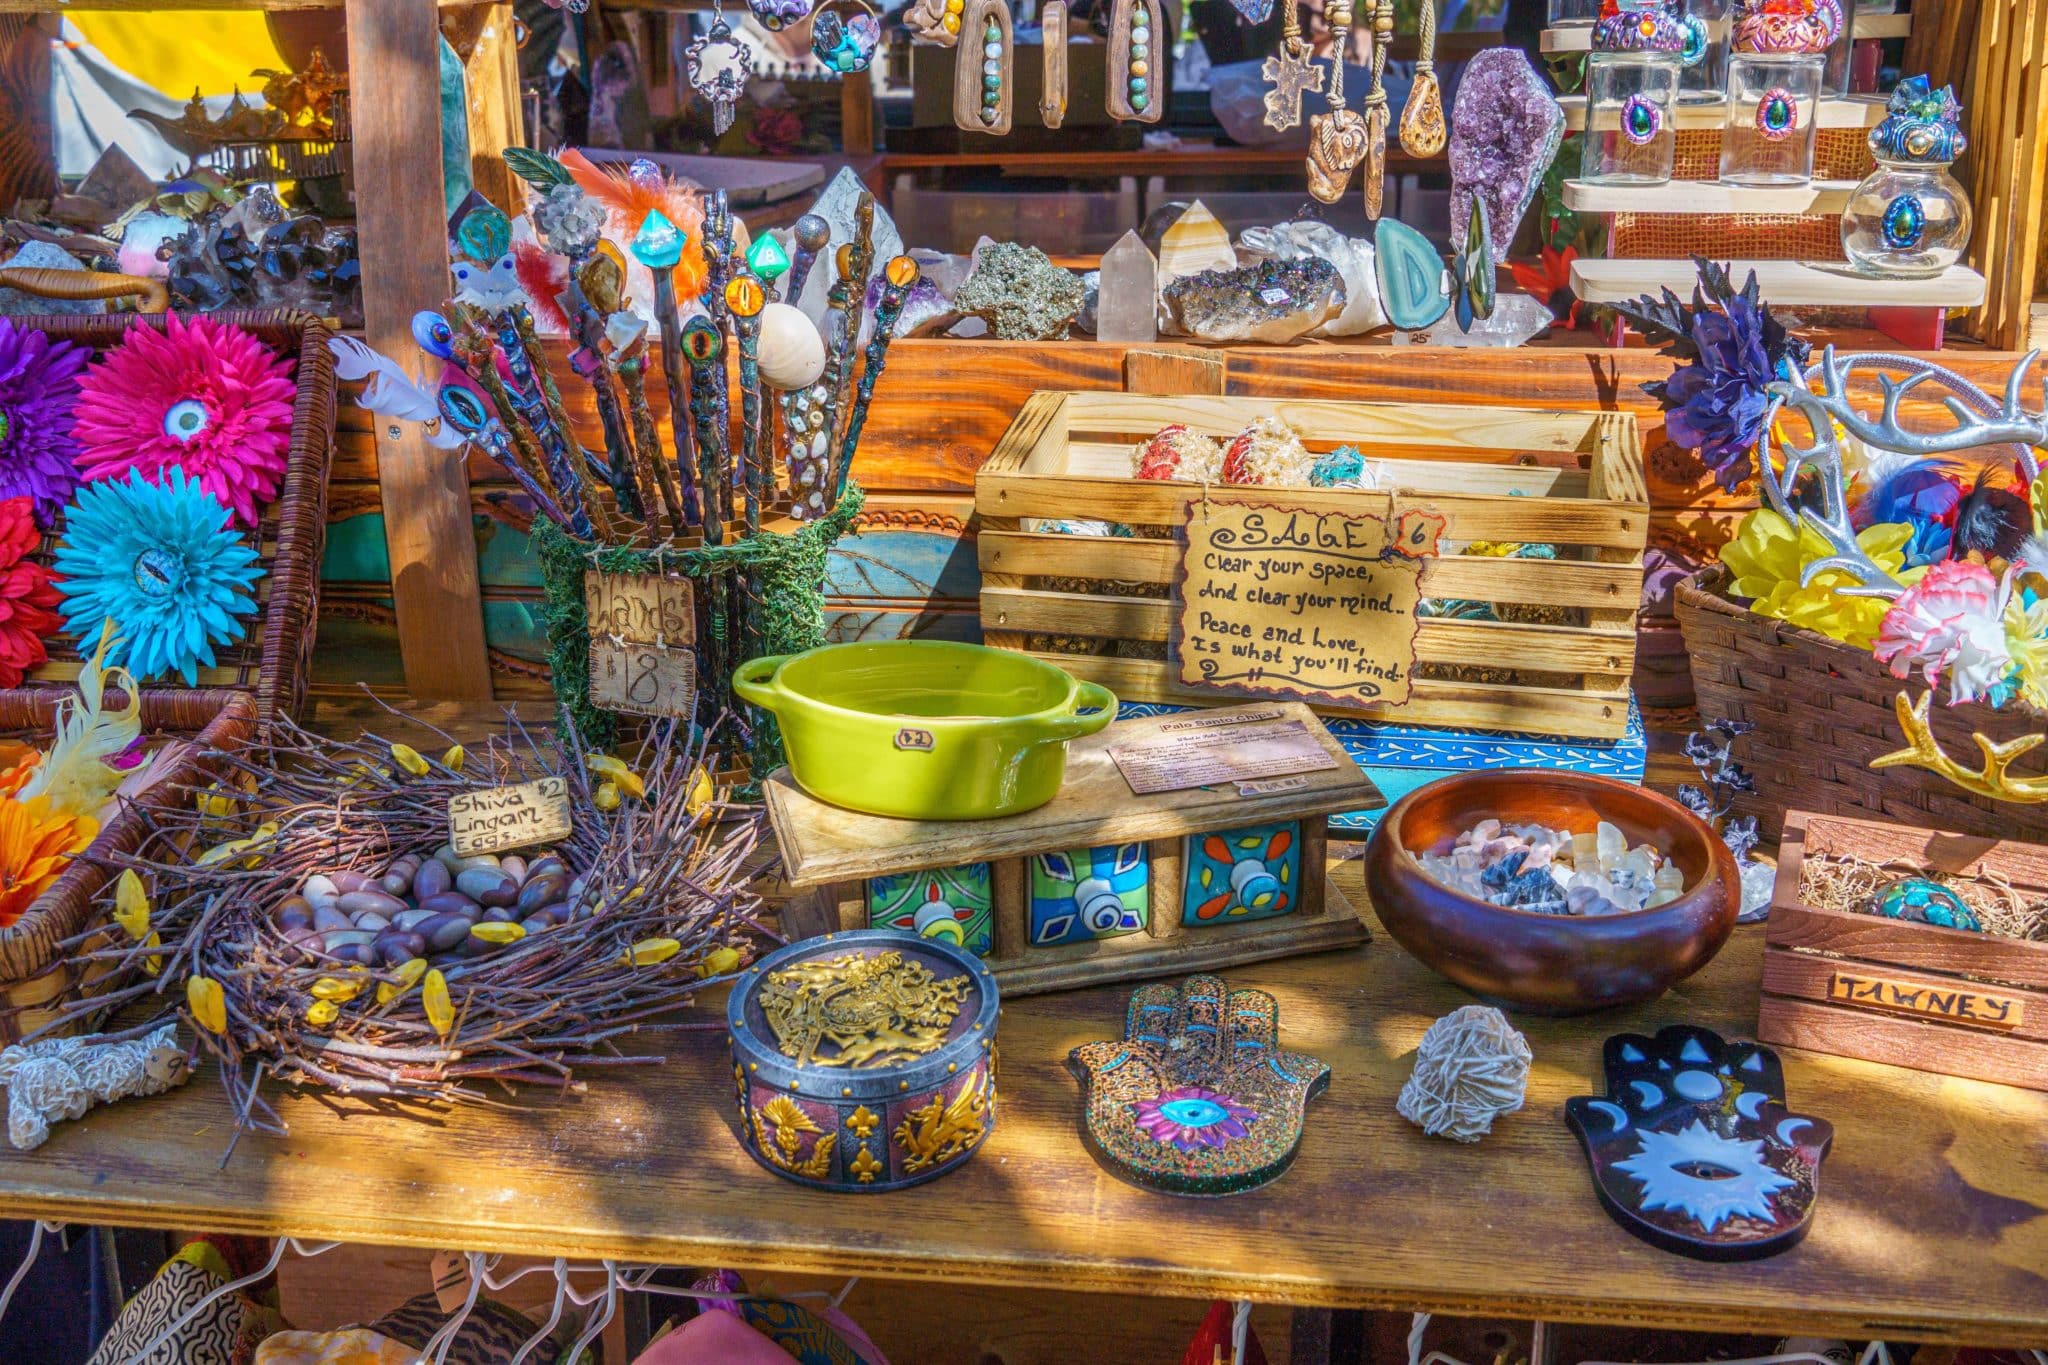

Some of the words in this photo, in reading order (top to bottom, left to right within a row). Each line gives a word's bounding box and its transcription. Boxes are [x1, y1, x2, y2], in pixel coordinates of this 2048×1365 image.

[1241, 514, 1367, 549] SAGE
[1410, 522, 1426, 545] 6
[1203, 553, 1252, 573] Clear
[1254, 558, 1304, 581] your
[1308, 562, 1373, 585] space,
[589, 575, 684, 634] Wands
[1199, 580, 1237, 601] And
[1246, 590, 1290, 606] clear
[1290, 594, 1336, 615] your
[1200, 612, 1252, 638] Peace
[1262, 626, 1304, 645] and
[1313, 627, 1365, 656] Love,
[1191, 636, 1221, 653] Is
[1232, 642, 1283, 663] what
[1289, 655, 1349, 675] you'll
[1162, 721, 1193, 731] Palo
[1195, 716, 1233, 726] Santo
[1236, 711, 1274, 722] Chips
[452, 794, 524, 813] Shiva
[453, 807, 543, 837] Lingam
[1839, 977, 2011, 1020] TAWNEY
